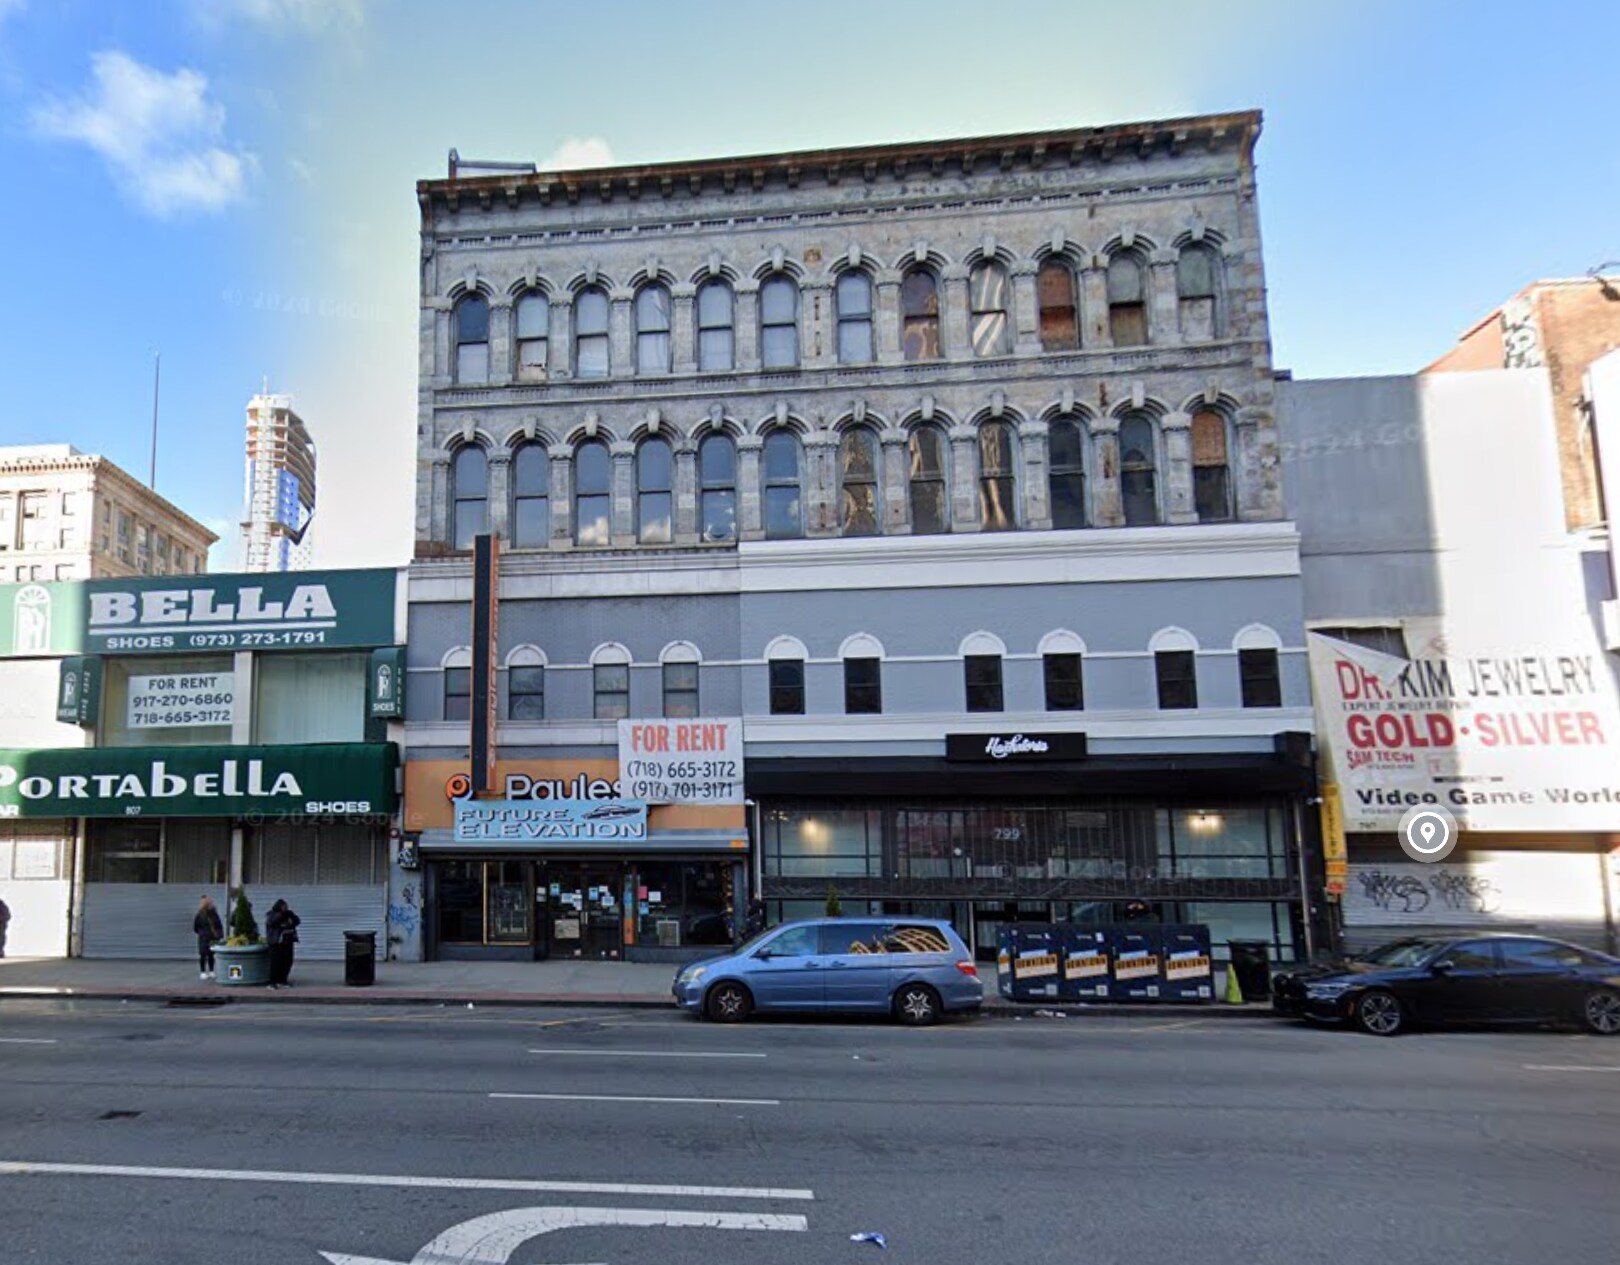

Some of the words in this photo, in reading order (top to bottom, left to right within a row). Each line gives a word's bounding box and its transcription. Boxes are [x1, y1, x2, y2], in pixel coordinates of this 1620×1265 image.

[89, 584, 337, 625] BELLA
[106, 635, 175, 649] SHOES
[189, 634, 236, 647] (973)
[241, 631, 326, 645] 273-1791
[148, 679, 176, 690] FOR
[180, 676, 218, 689] RENT
[1398, 658, 1455, 697] KIM
[1467, 655, 1596, 697] JEWELRY
[132, 693, 233, 708] 917-270-6860
[134, 710, 231, 724] 718-665-3172
[631, 725, 670, 752] FOR
[676, 724, 728, 752] RENT
[1346, 713, 1455, 749] GOLD
[1473, 711, 1606, 747] SILVER
[627, 760, 663, 779] (718)
[667, 761, 736, 778] 665-3172
[632, 780, 668, 798] (917)
[671, 782, 733, 798] 701-3171
[1356, 788, 1438, 806] Video
[1449, 787, 1534, 806] Game
[1545, 786, 1620, 804] Worl
[304, 801, 371, 813] SHOES
[459, 822, 646, 839] ELEVATION
[993, 828, 1021, 840] 799
